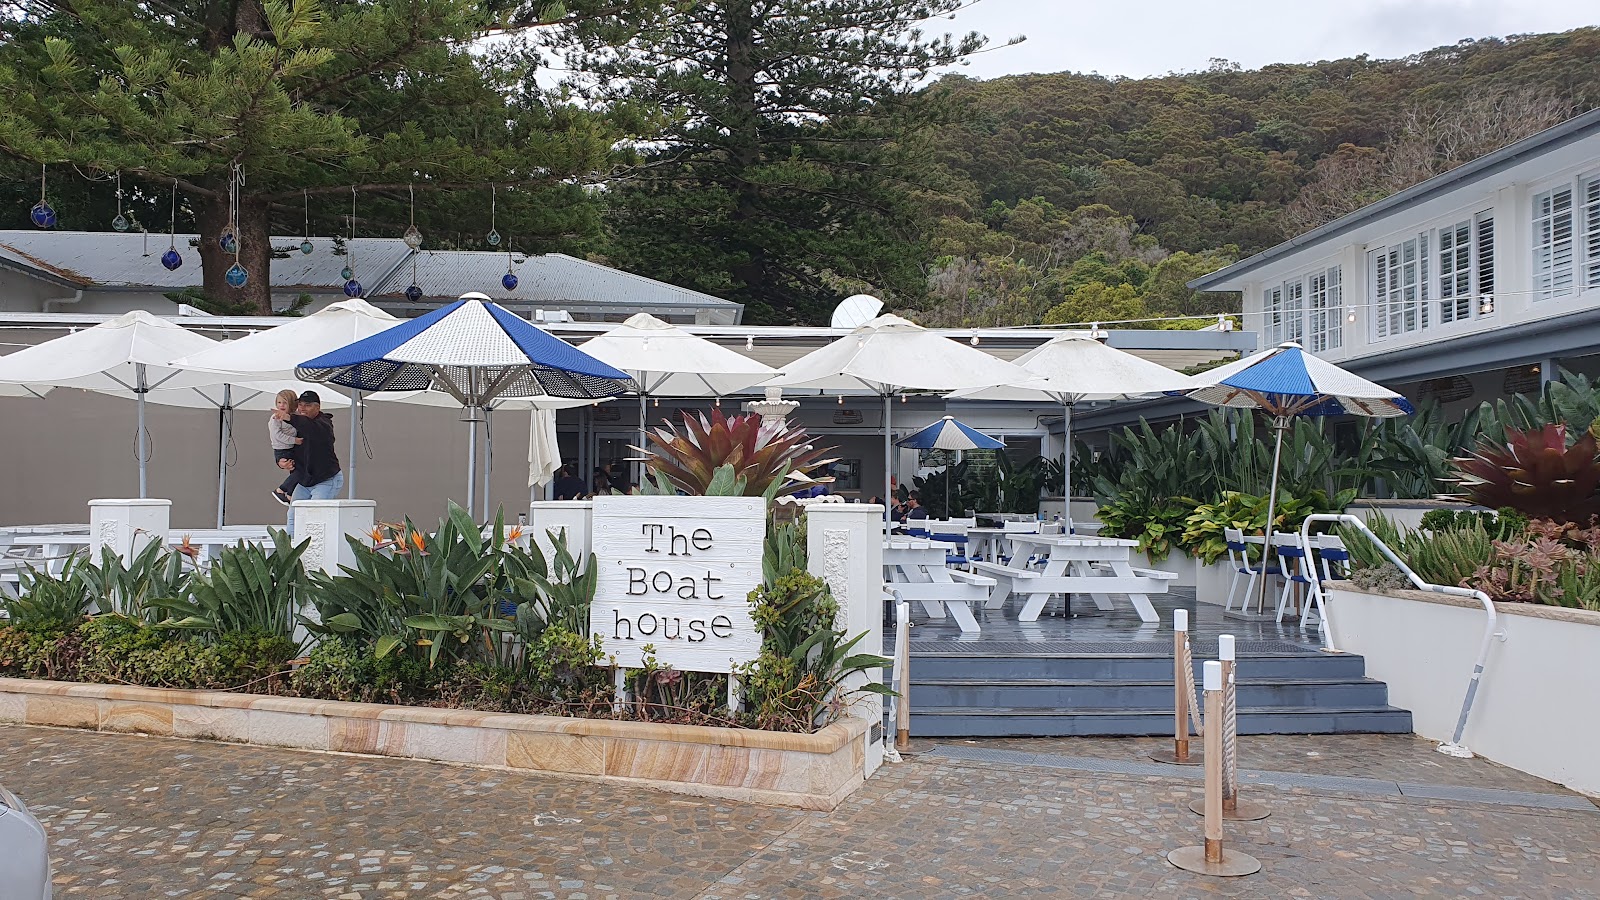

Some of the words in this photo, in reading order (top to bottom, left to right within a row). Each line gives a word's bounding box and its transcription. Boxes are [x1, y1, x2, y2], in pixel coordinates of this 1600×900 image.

[642, 523, 713, 556] The
[625, 567, 724, 600] Boat
[612, 609, 734, 643] house
